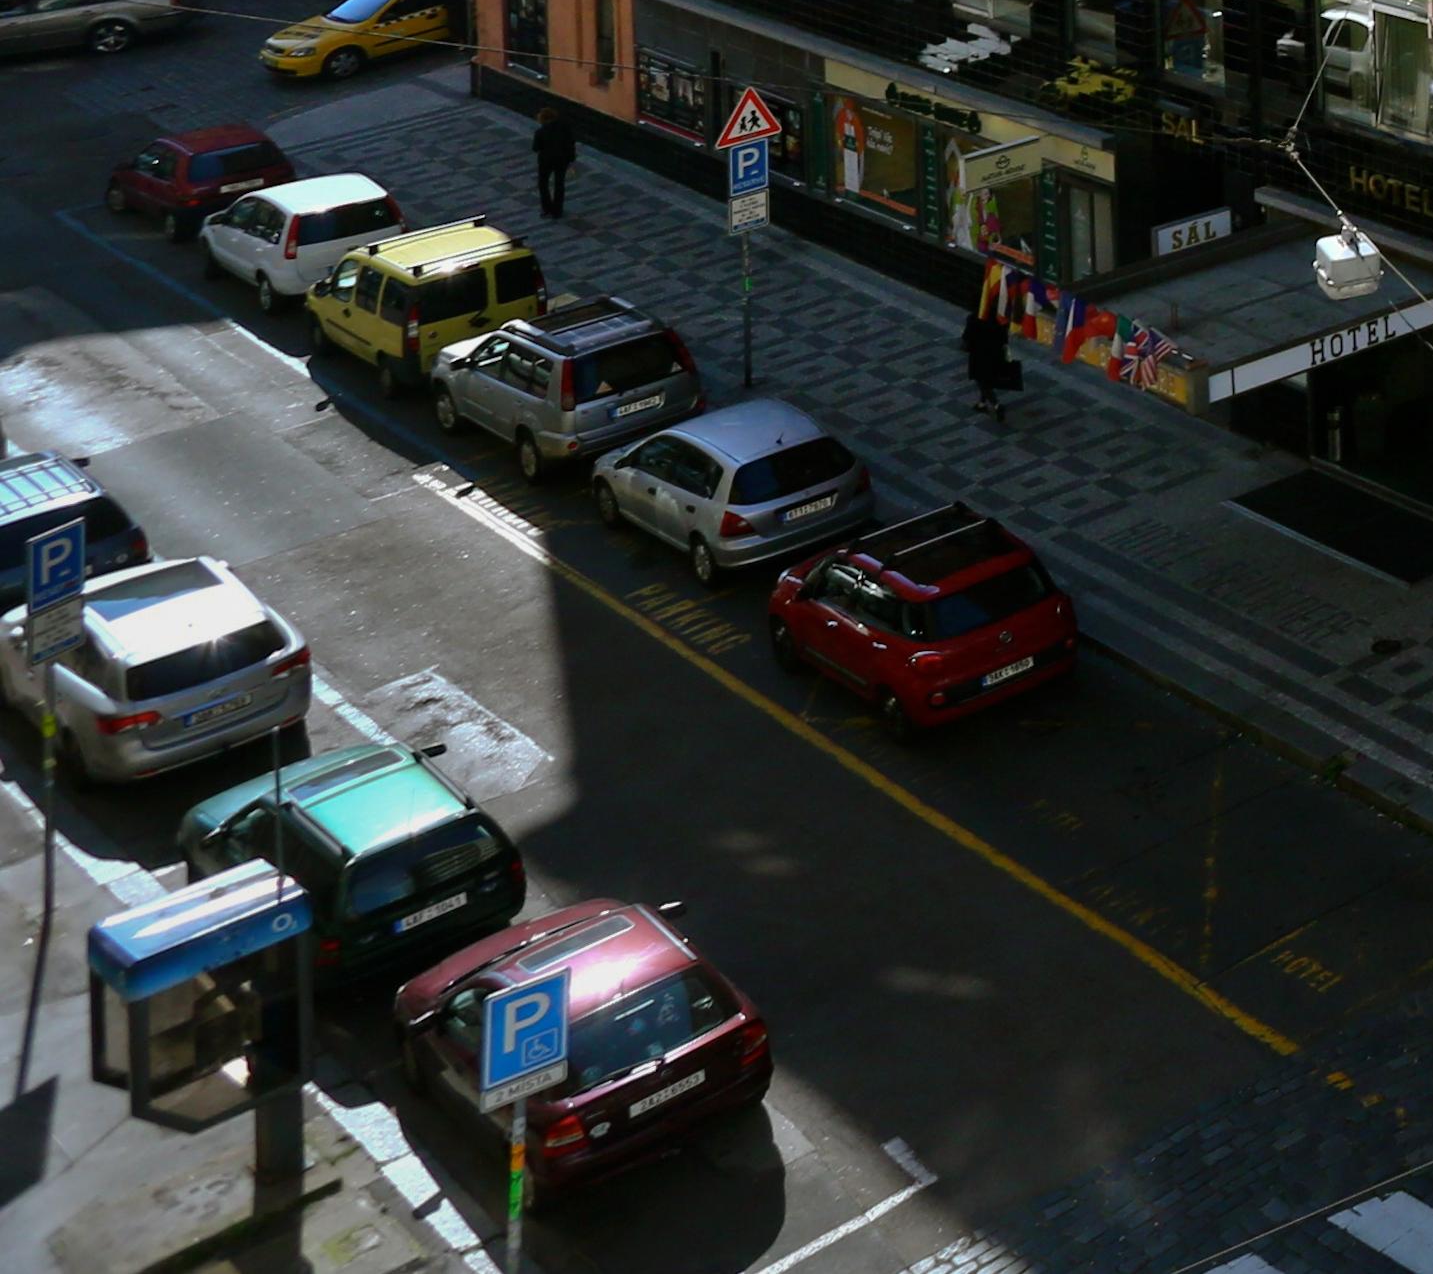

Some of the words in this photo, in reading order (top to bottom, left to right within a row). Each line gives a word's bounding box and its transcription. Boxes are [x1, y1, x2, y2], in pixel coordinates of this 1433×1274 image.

[737, 147, 760, 179] P
[1171, 220, 1217, 251] SÁL
[1310, 316, 1397, 366] HOTEL
[40, 536, 74, 586] P
[624, 582, 753, 654] PARKING
[1270, 949, 1344, 994] HOTEL
[503, 991, 551, 1054] P
[496, 1091, 506, 1103] 2
